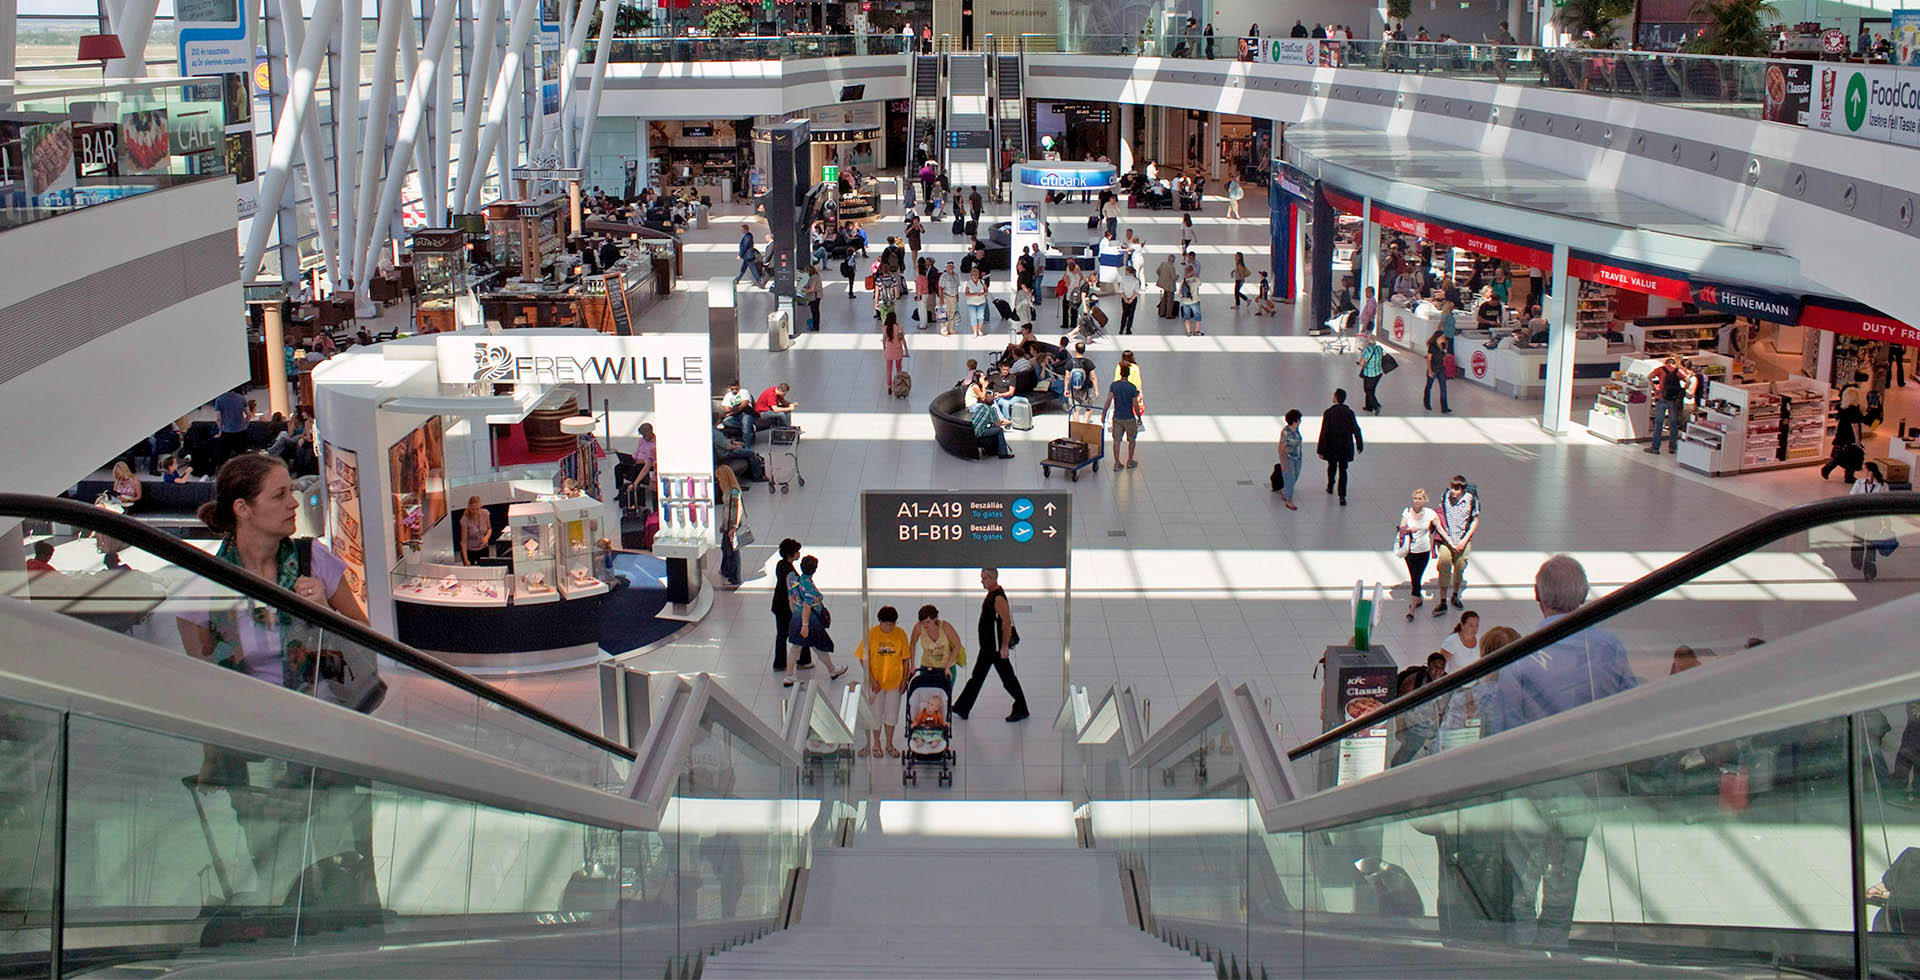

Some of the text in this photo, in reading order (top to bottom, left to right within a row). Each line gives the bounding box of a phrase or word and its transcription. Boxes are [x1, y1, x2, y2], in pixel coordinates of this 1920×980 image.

[1787, 68, 1799, 78] KFC
[1786, 81, 1810, 94] Classic
[1899, 115, 1916, 132] Taste
[82, 130, 116, 166] BAR
[1040, 172, 1087, 187] citibank
[1468, 239, 1498, 253] DUTY FREE
[1600, 270, 1657, 290] TRAVEL VALUE
[1862, 321, 1896, 336] DUTY
[515, 356, 704, 384] FREYWILLE
[970, 501, 1003, 510] Beszállás
[972, 510, 1003, 520] To gates
[970, 524, 1003, 533] Beszállás
[972, 533, 1003, 542] To gates
[1346, 686, 1389, 697] Classic
